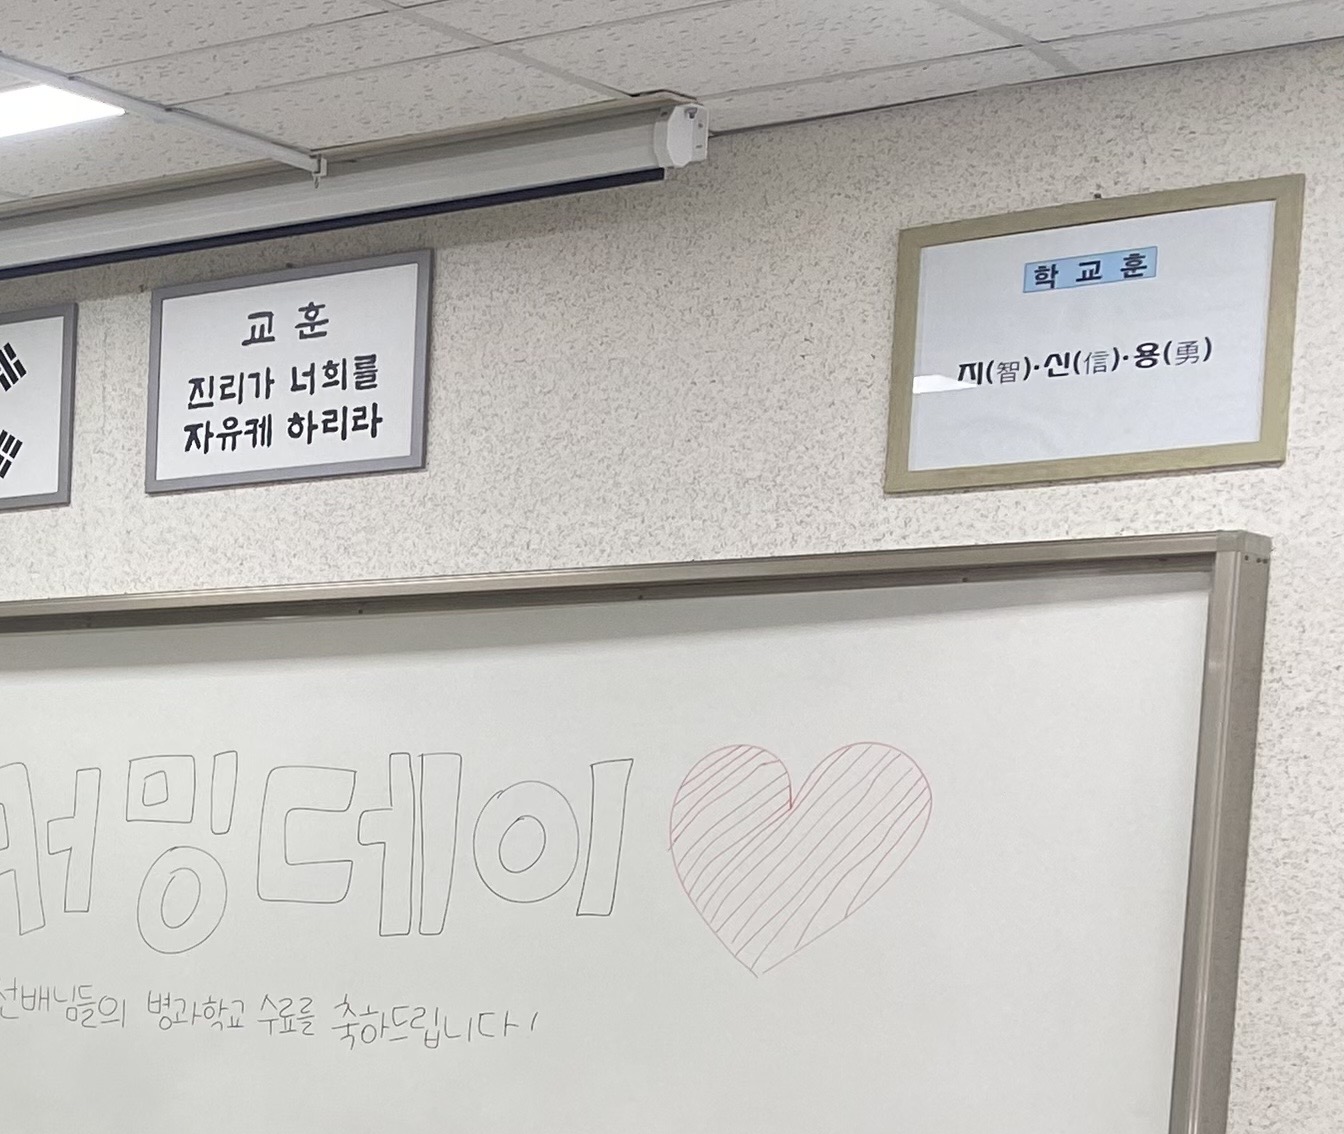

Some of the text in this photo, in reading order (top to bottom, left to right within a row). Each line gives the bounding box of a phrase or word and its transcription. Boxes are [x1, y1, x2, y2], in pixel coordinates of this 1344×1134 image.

[187, 353, 378, 409] 진리가 너희를
[183, 402, 383, 454] 자유케 하리라
[147, 989, 244, 1031] 병과학교
[257, 993, 315, 1036] 수료를
